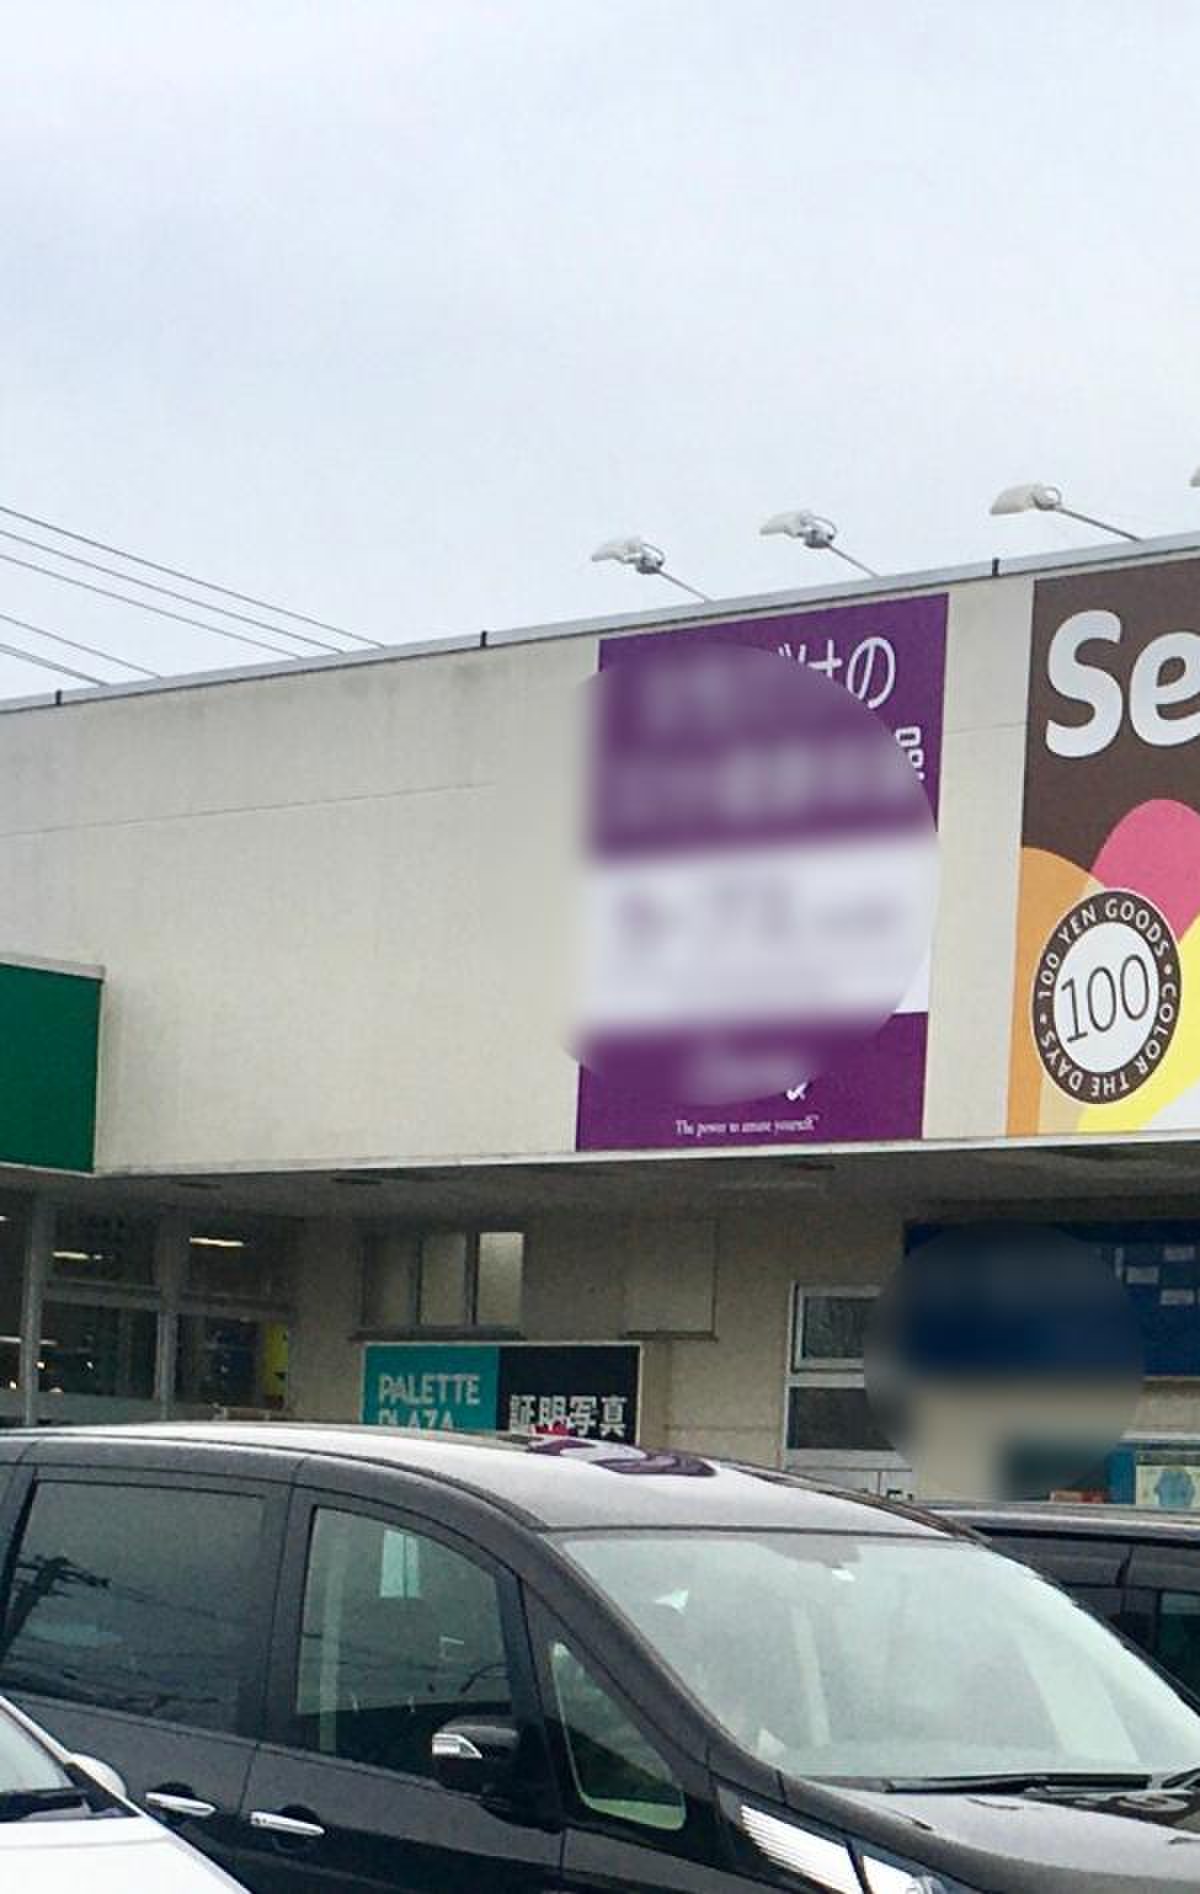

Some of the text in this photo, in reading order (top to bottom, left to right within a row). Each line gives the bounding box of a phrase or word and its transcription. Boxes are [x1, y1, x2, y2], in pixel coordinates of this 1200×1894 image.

[1038, 898, 1170, 1000] 100 YEN GOODS
[1040, 983, 1177, 1097] COLOR THE DAYS
[1060, 953, 1150, 1043] 100
[379, 1373, 480, 1405] PALETTE
[510, 1395, 626, 1438] 証明写真
